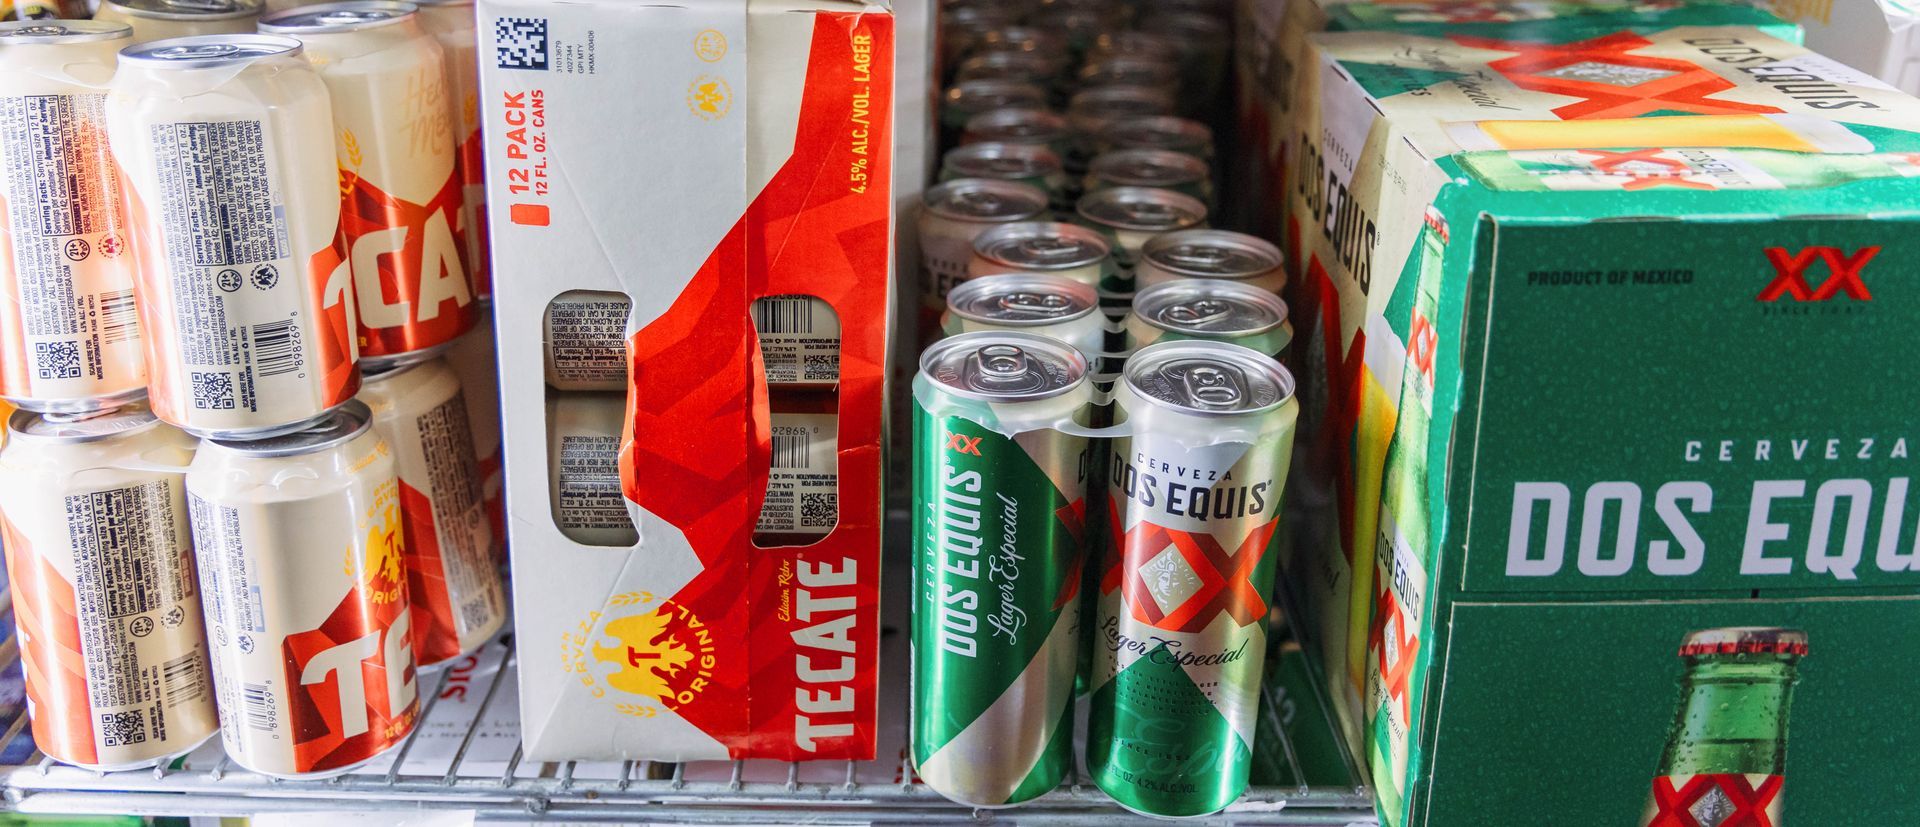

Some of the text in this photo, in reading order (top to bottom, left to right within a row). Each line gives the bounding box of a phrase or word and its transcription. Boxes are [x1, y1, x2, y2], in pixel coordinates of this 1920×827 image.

[1681, 38, 1781, 63] DOS
[1737, 66, 1880, 110] EQUIS
[30, 122, 39, 131] 12
[850, 36, 870, 194] 4.5% ALC./VOL. LAGER
[33, 134, 41, 148] size
[188, 124, 198, 151] Serving:
[198, 134, 207, 153] Protein
[236, 121, 246, 152] BEVERAGES
[244, 120, 254, 144] OPERATE
[253, 120, 263, 153] PROBLEMS
[504, 91, 530, 194] 12 PACK
[531, 90, 548, 196] 12 FL. OZ. CANS
[35, 150, 45, 178] Serving
[181, 150, 190, 159] 12
[192, 153, 203, 163] per
[247, 146, 256, 155] OR
[249, 157, 257, 167] CAR
[184, 162, 192, 176] size
[193, 165, 203, 189] Amount
[202, 165, 210, 174] Fat
[240, 153, 250, 182] ALCOHOLIC
[257, 154, 266, 176] HEALTH
[39, 180, 48, 203] Facts:
[187, 179, 196, 206] Serving
[251, 175, 260, 191] DRIVE
[260, 177, 269, 197] CAUSE
[43, 206, 52, 234] Serving
[191, 209, 200, 232] Facts:
[207, 188, 219, 227] Carbohydrates
[245, 191, 256, 229] CONSUMPTION
[255, 203, 264, 222] ABILITY
[203, 228, 212, 238] per
[258, 223, 266, 238] YOUR
[1324, 168, 1376, 297] EQUIS
[70, 243, 78, 256] 21+
[195, 235, 204, 264] Serving
[204, 239, 214, 264] Servings
[214, 242, 223, 263] Calories
[260, 240, 269, 261] IMPAIRS
[221, 274, 231, 287] 21+
[1528, 270, 1694, 286] PRODUCT OF MEXICO
[1756, 245, 1882, 302] XX
[204, 332, 214, 365] QUESTIONS?
[290, 325, 304, 366] 898269
[946, 431, 983, 457] XX
[1684, 438, 1908, 462] CERVEZA
[1138, 453, 1232, 480] CERVEZA
[1113, 452, 1157, 508] DOS
[1166, 479, 1268, 522] EQUIS
[1505, 481, 1713, 577] DOS
[926, 501, 937, 602] CERVEZA
[939, 464, 983, 658] DOS EQUIS
[987, 492, 1027, 645] Lager Especial
[1380, 527, 1394, 577] DOS
[1394, 558, 1420, 622] EQUIS
[778, 560, 794, 622] Edición Retro
[573, 609, 605, 698] CERVEZA
[677, 604, 716, 704] ORIGINAL
[790, 556, 857, 752] TECATE
[1101, 614, 1148, 655] Lager
[1150, 636, 1249, 672] Especial
[265, 692, 278, 728] 898269
